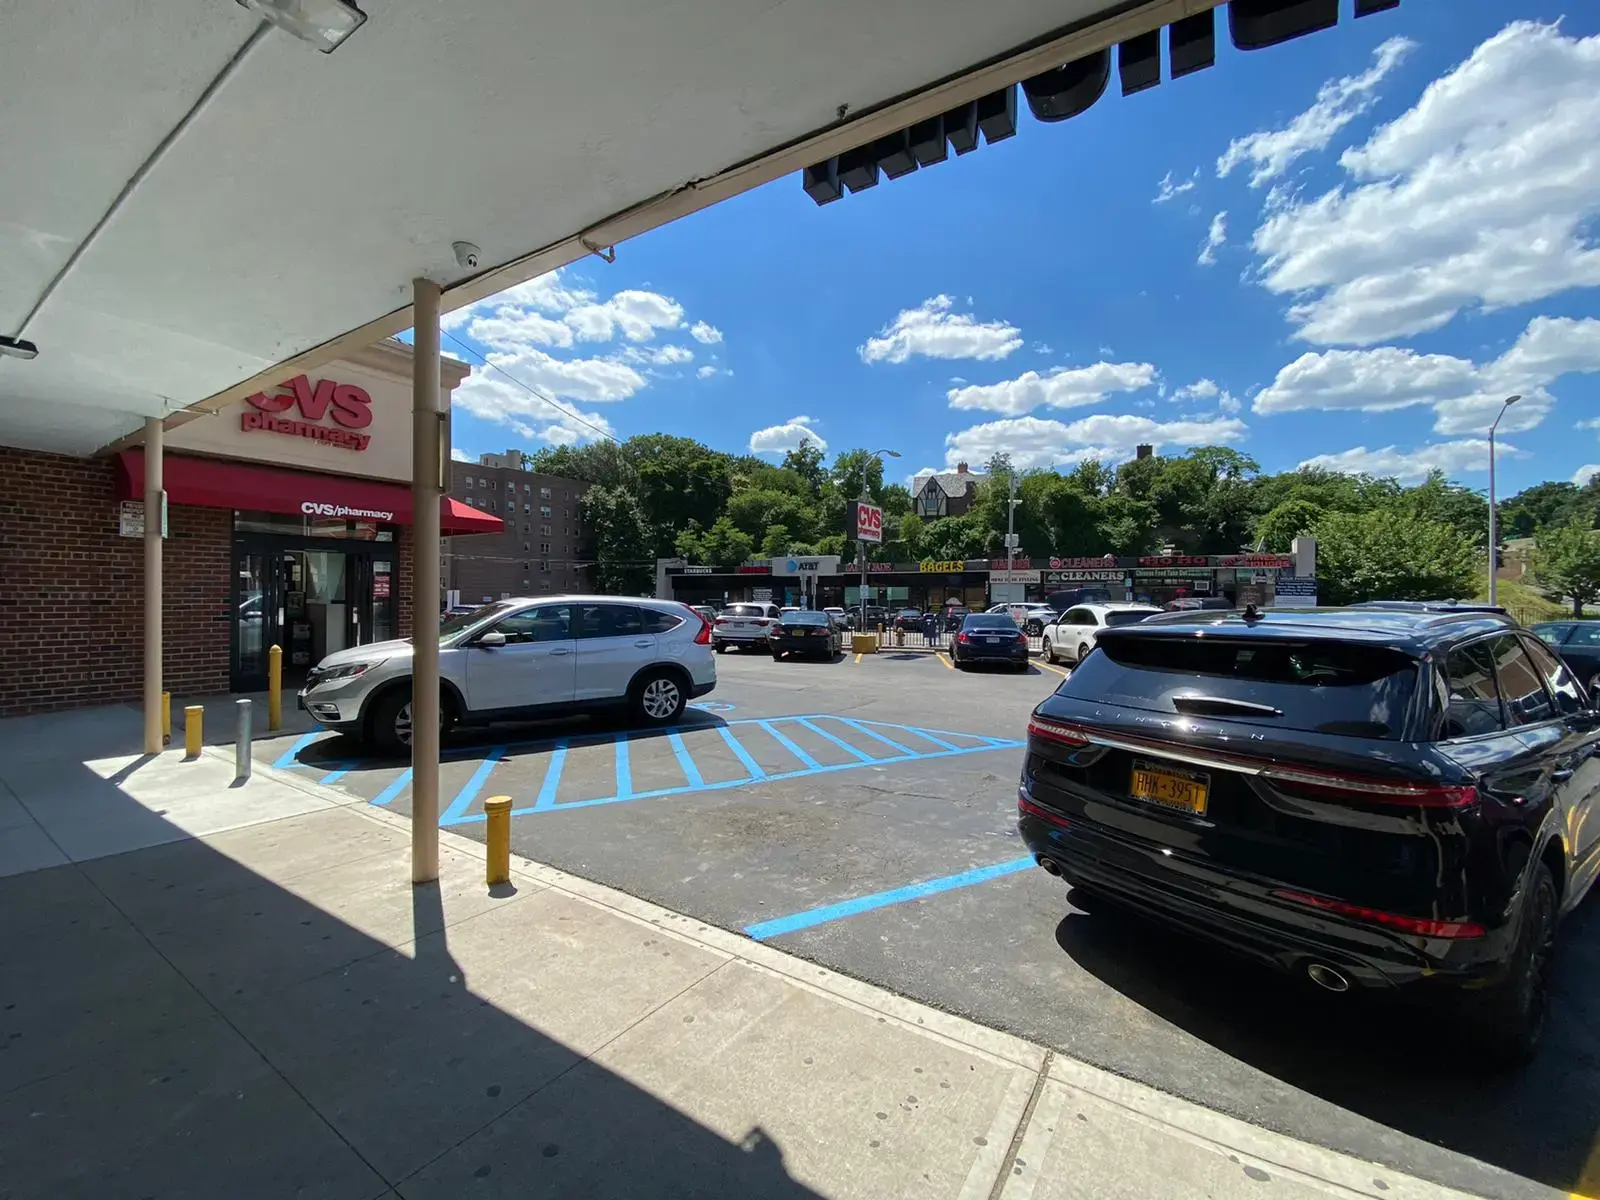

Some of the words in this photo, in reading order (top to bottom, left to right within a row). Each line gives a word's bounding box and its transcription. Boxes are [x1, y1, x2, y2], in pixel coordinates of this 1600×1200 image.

[241, 411, 371, 451] pharmacy
[859, 505, 881, 529] CVS
[798, 561, 819, 571] AT&T
[919, 560, 966, 572] BAGELS
[1061, 558, 1116, 568] CLEANERS
[1061, 571, 1124, 580] CLEANERS
